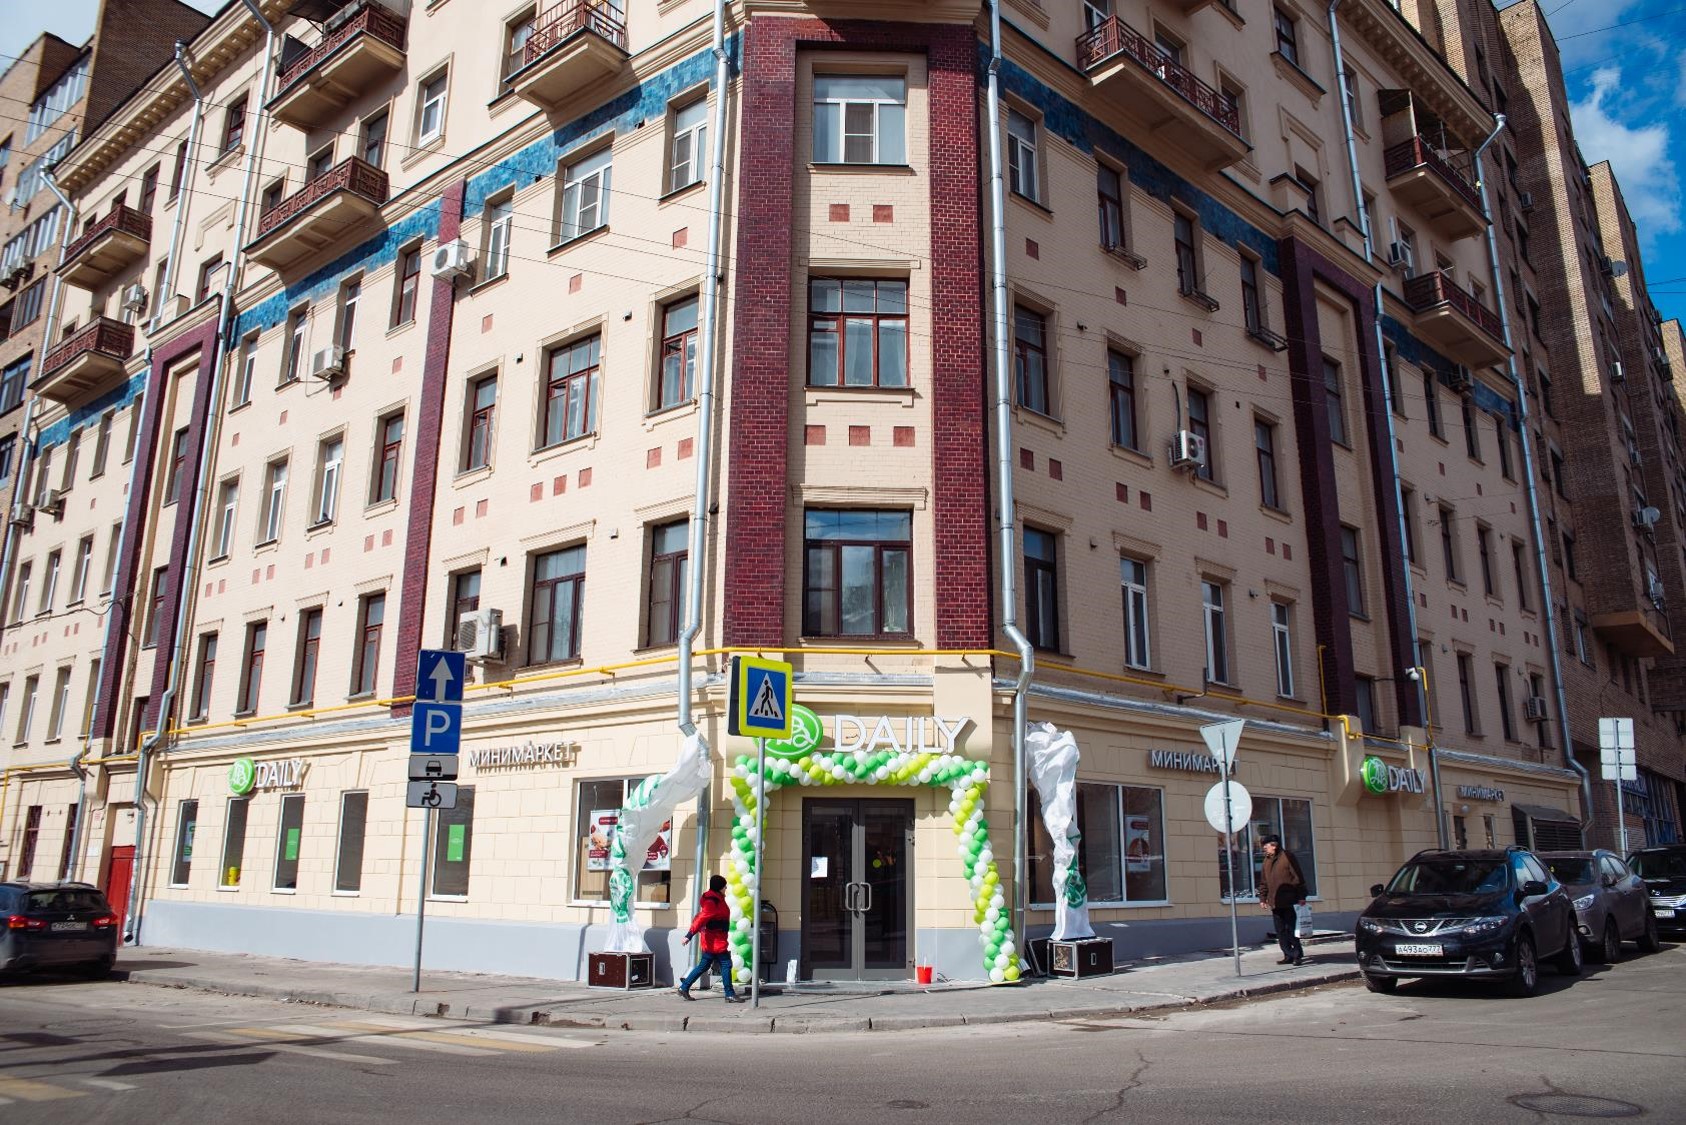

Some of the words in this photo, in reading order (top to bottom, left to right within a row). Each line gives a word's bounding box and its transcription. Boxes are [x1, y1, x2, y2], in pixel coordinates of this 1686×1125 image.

[424, 709, 451, 747] P
[834, 714, 970, 753] DAILY
[468, 742, 577, 768] МИНИМАРКЕТ
[1150, 749, 1240, 774] МИНИМАРТ
[255, 758, 305, 788] DAILY
[1388, 765, 1427, 794] DAILY
